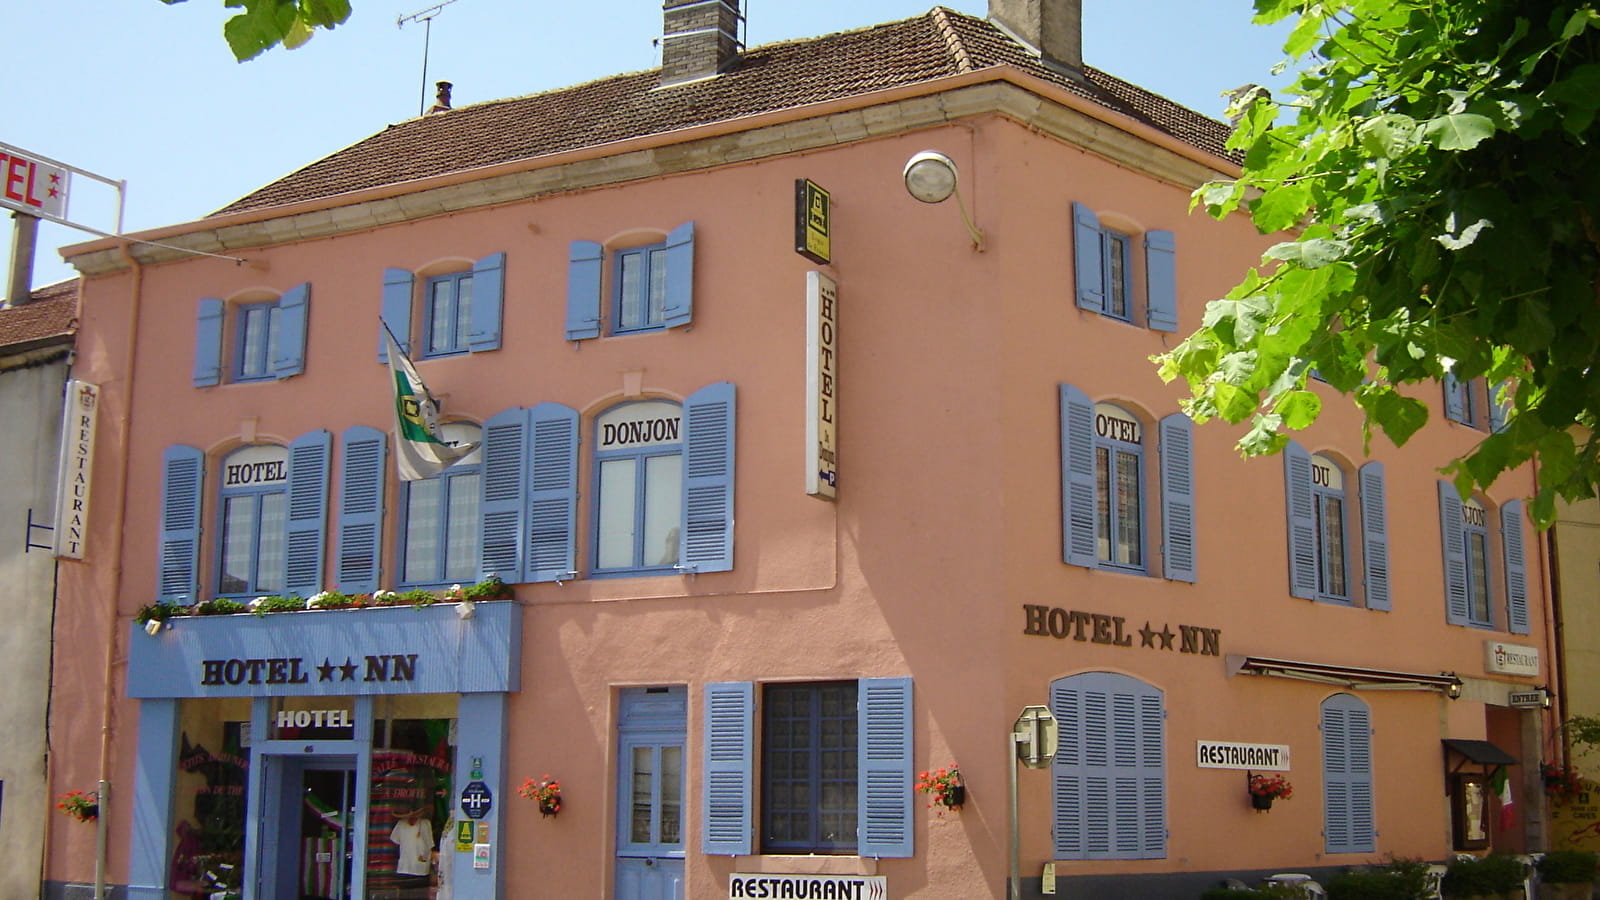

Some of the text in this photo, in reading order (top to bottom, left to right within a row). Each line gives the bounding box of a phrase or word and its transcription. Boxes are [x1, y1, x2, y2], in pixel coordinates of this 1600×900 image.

[821, 294, 834, 424] HOTEL
[602, 417, 681, 446] DONJON
[1095, 413, 1142, 446] OTEL
[69, 415, 91, 554] RESTAURANT
[226, 460, 288, 485] HOTEL
[1311, 463, 1330, 488] DU
[1023, 603, 1222, 657] HOTEL NN
[200, 653, 419, 686] HOTEL NN
[276, 709, 353, 729] HOTEL
[1200, 744, 1280, 767] RESTAURANT
[731, 877, 865, 900] RESTAURANT
